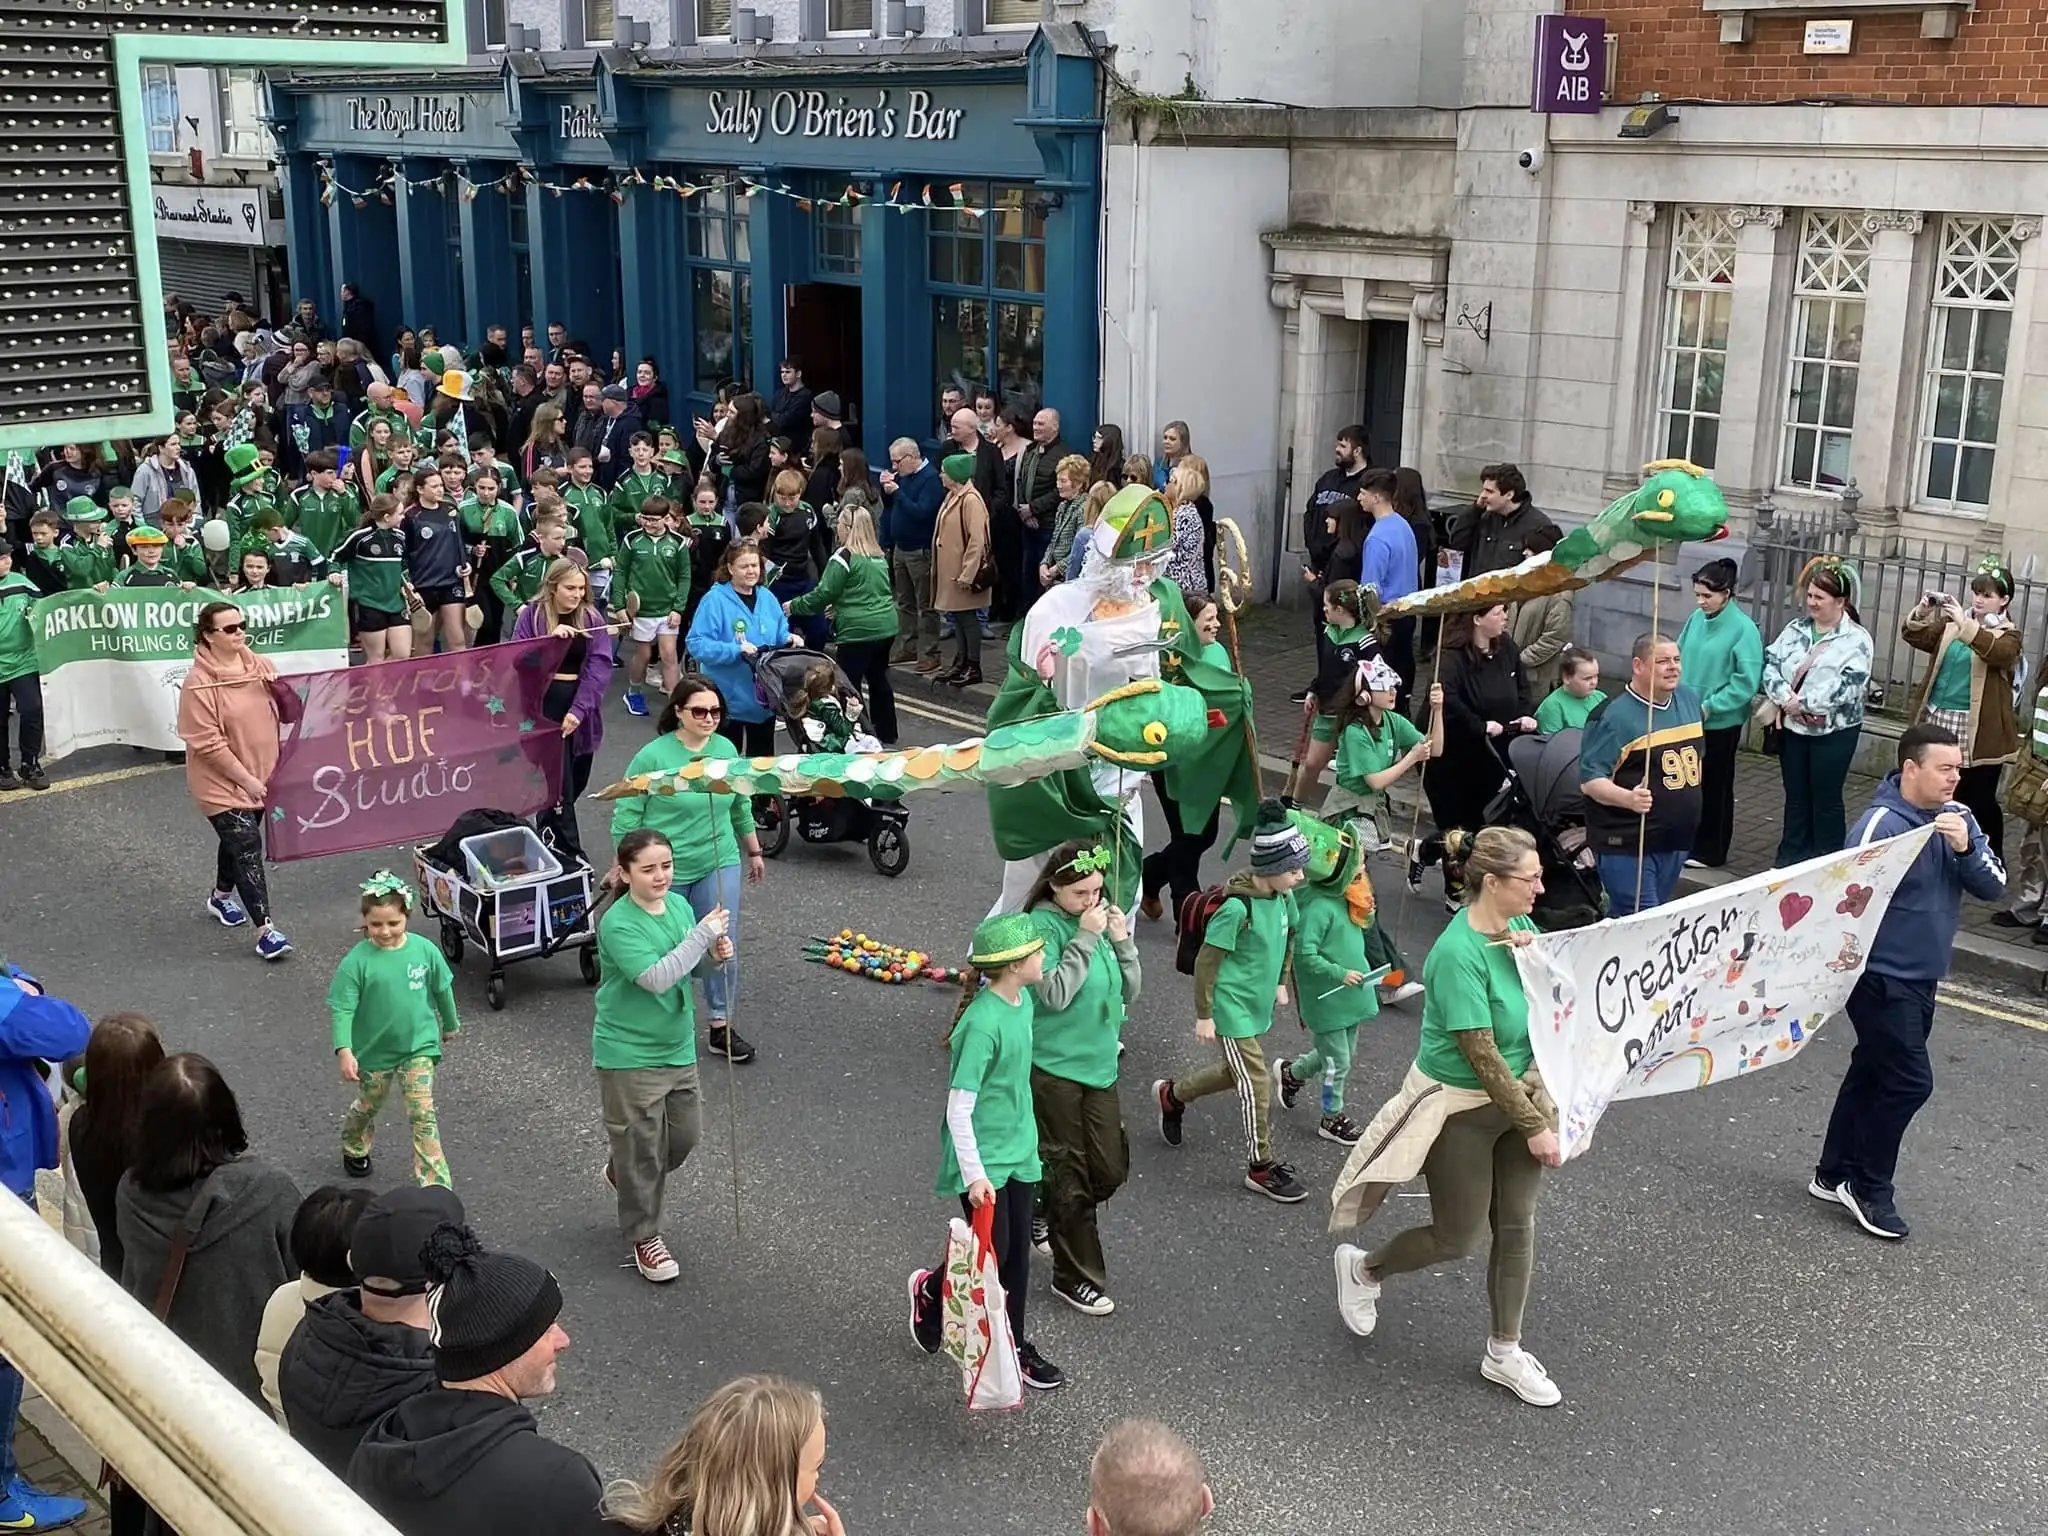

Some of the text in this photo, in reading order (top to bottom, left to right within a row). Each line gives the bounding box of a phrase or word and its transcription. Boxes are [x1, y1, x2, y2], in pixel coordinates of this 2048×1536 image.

[1556, 75, 1590, 101] AIB
[347, 97, 462, 138] The Royal Hotel
[560, 104, 604, 139] Fáilt
[706, 90, 962, 143] Sally O'Brien's Bar
[44, 601, 138, 641] ARKLOW
[91, 633, 172, 653] HURLING
[176, 633, 189, 650] &
[344, 705, 444, 772] HOF
[1661, 745, 1700, 791] 98
[296, 757, 476, 834] Studio
[1595, 907, 1738, 1033] Creation
